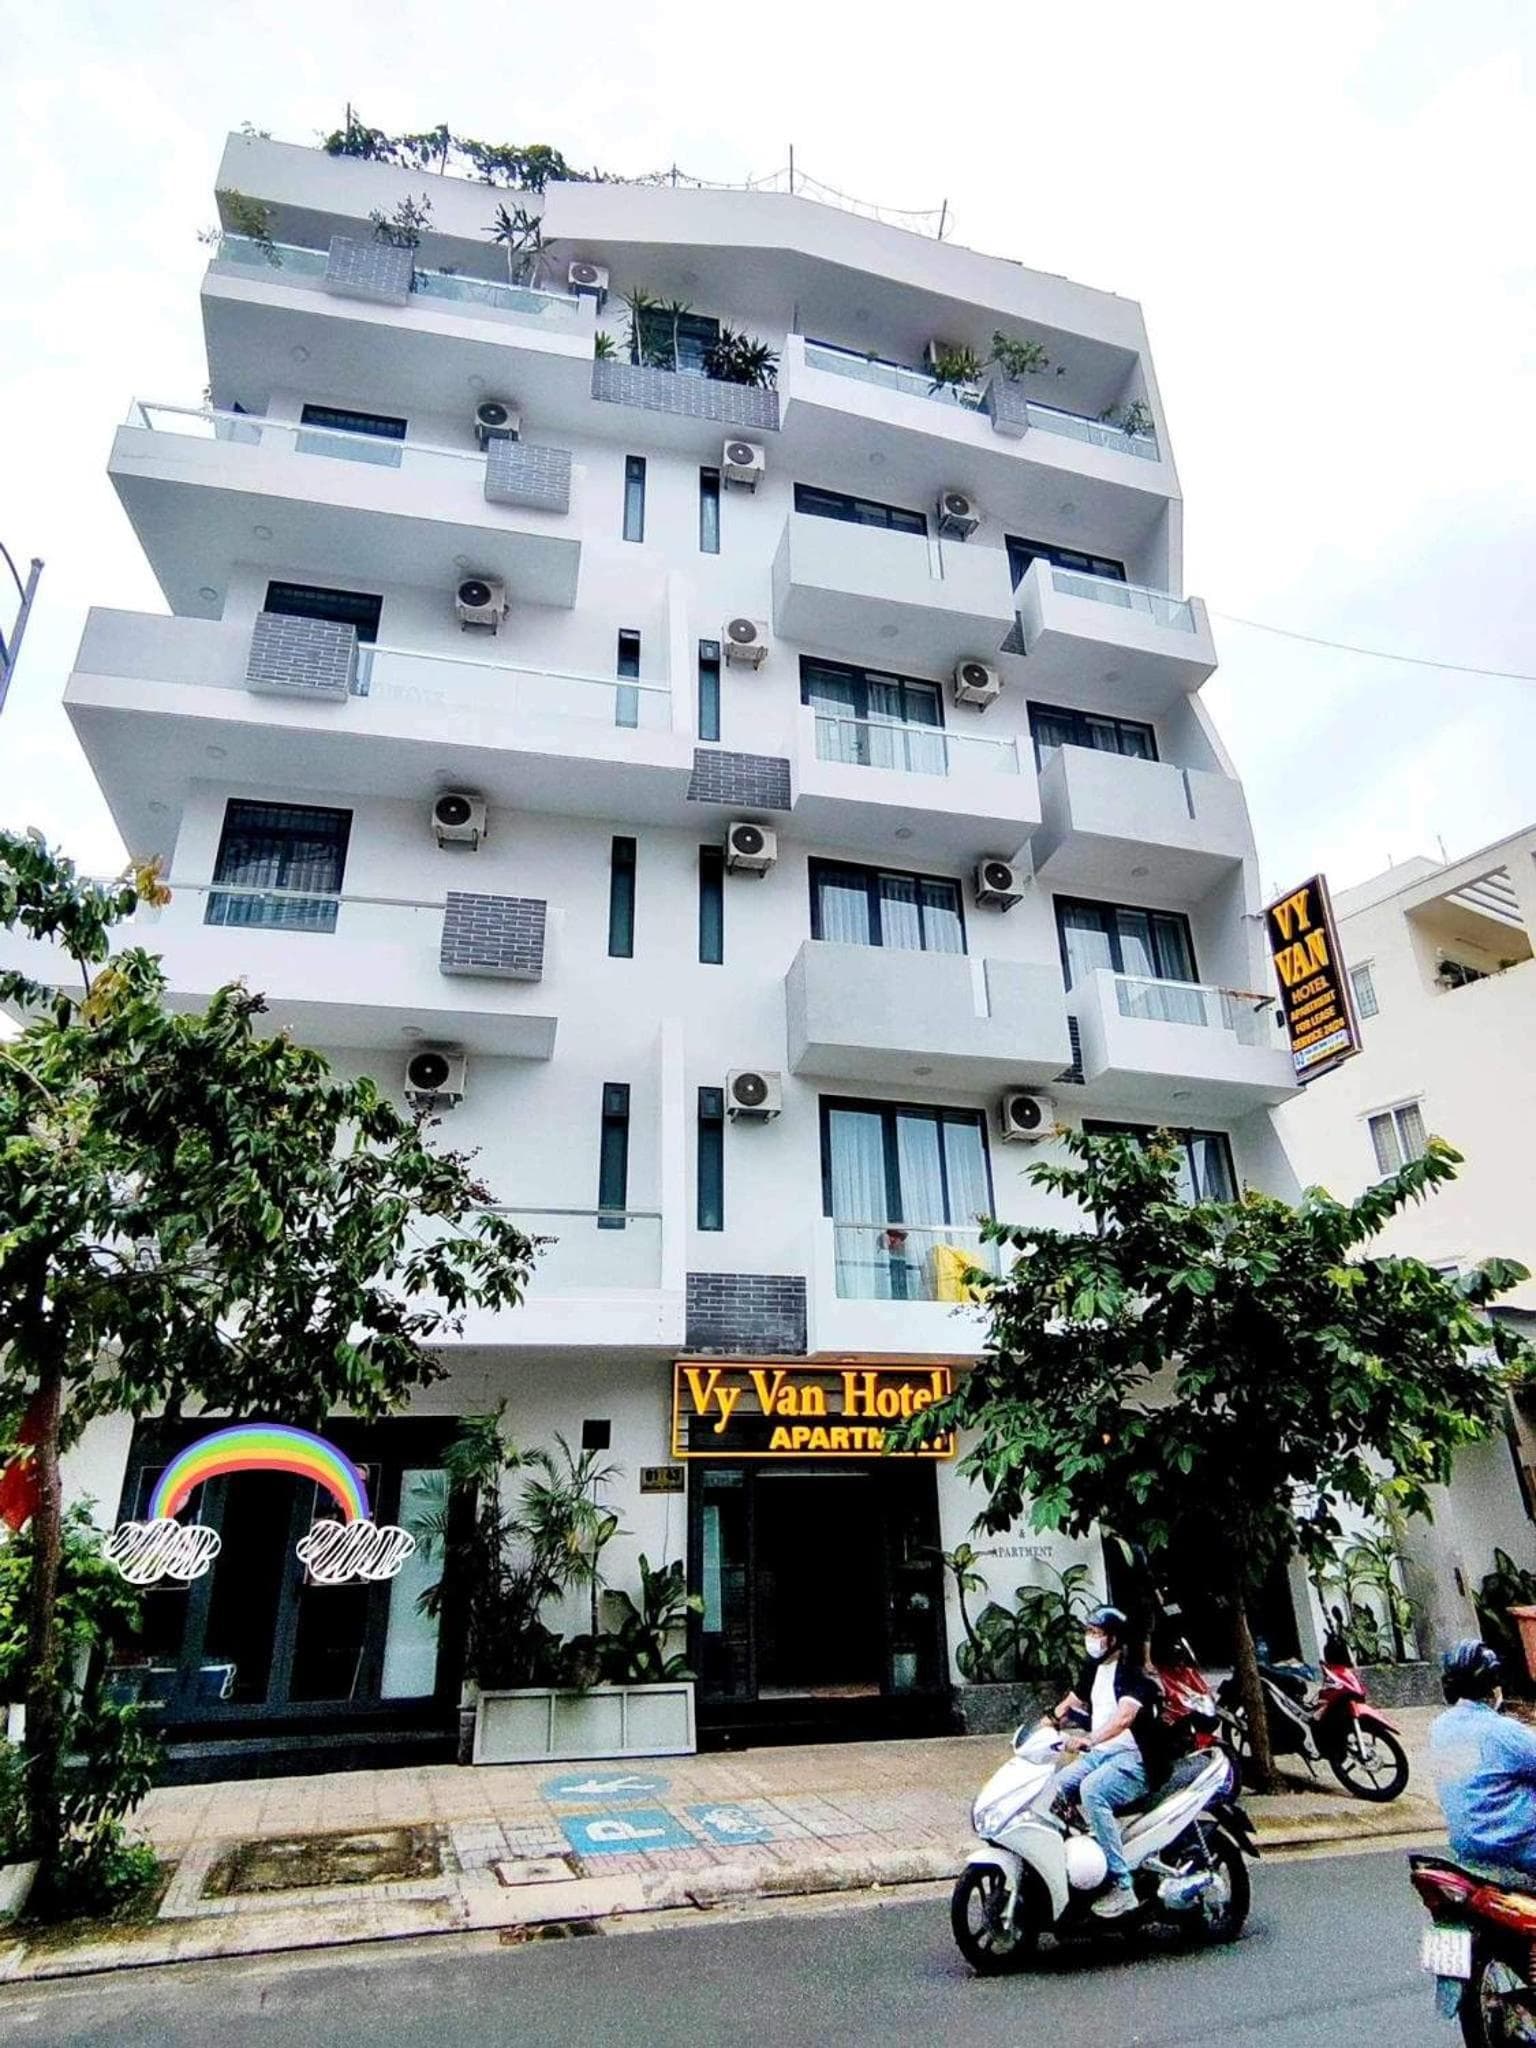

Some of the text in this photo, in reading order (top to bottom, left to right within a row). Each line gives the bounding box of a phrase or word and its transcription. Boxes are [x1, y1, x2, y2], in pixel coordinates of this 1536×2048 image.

[1272, 888, 1311, 940] VY
[1274, 927, 1329, 987] VAN
[1292, 976, 1330, 1004] HOTEL
[1295, 1005, 1336, 1034] FOR LEASE
[683, 1368, 942, 1433] Vy Van Hotel
